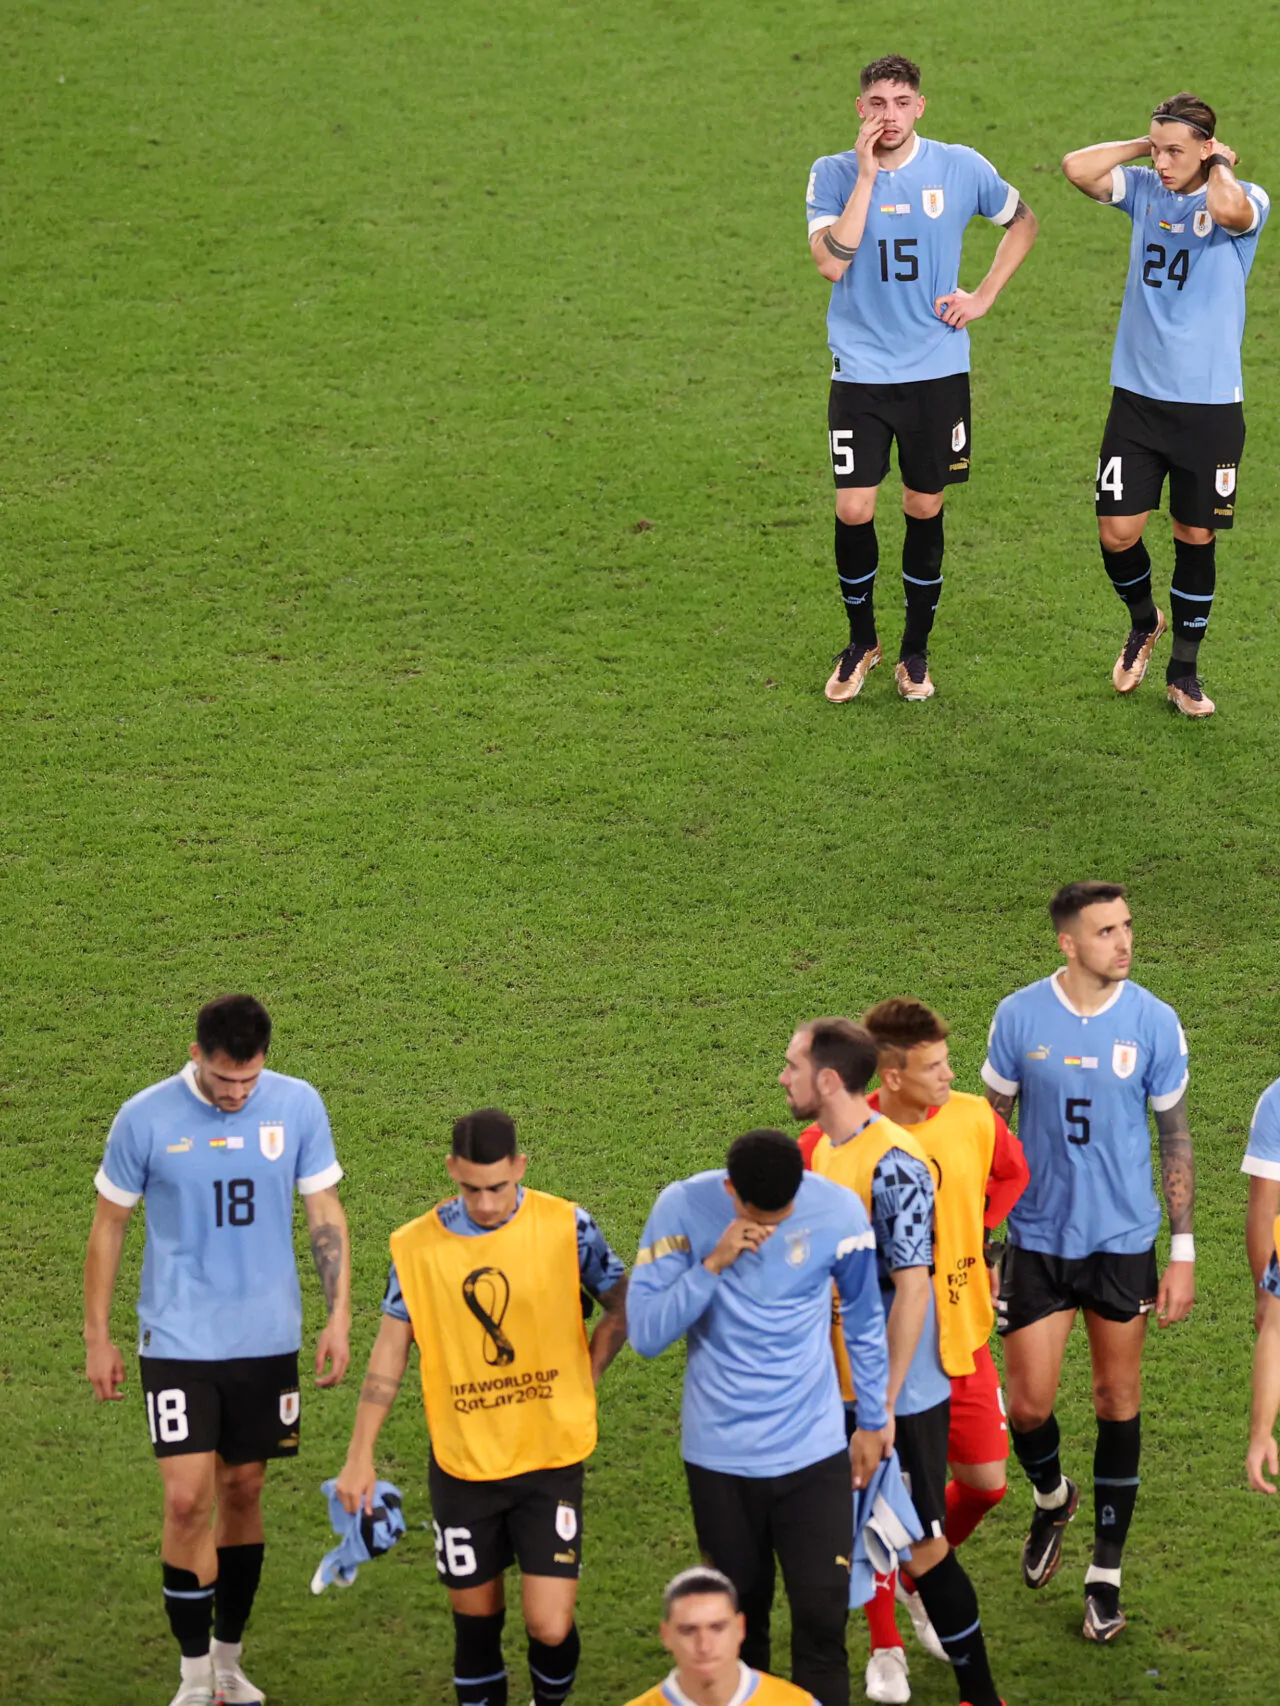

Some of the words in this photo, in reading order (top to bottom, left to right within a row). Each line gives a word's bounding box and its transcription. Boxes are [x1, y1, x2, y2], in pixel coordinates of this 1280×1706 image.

[878, 239, 919, 282] 15
[1143, 243, 1189, 290] 24
[828, 430, 855, 475] 5
[1096, 456, 1124, 501] 4
[1066, 1098, 1092, 1146] 5
[213, 1178, 255, 1228] 18
[146, 1388, 189, 1443] 18
